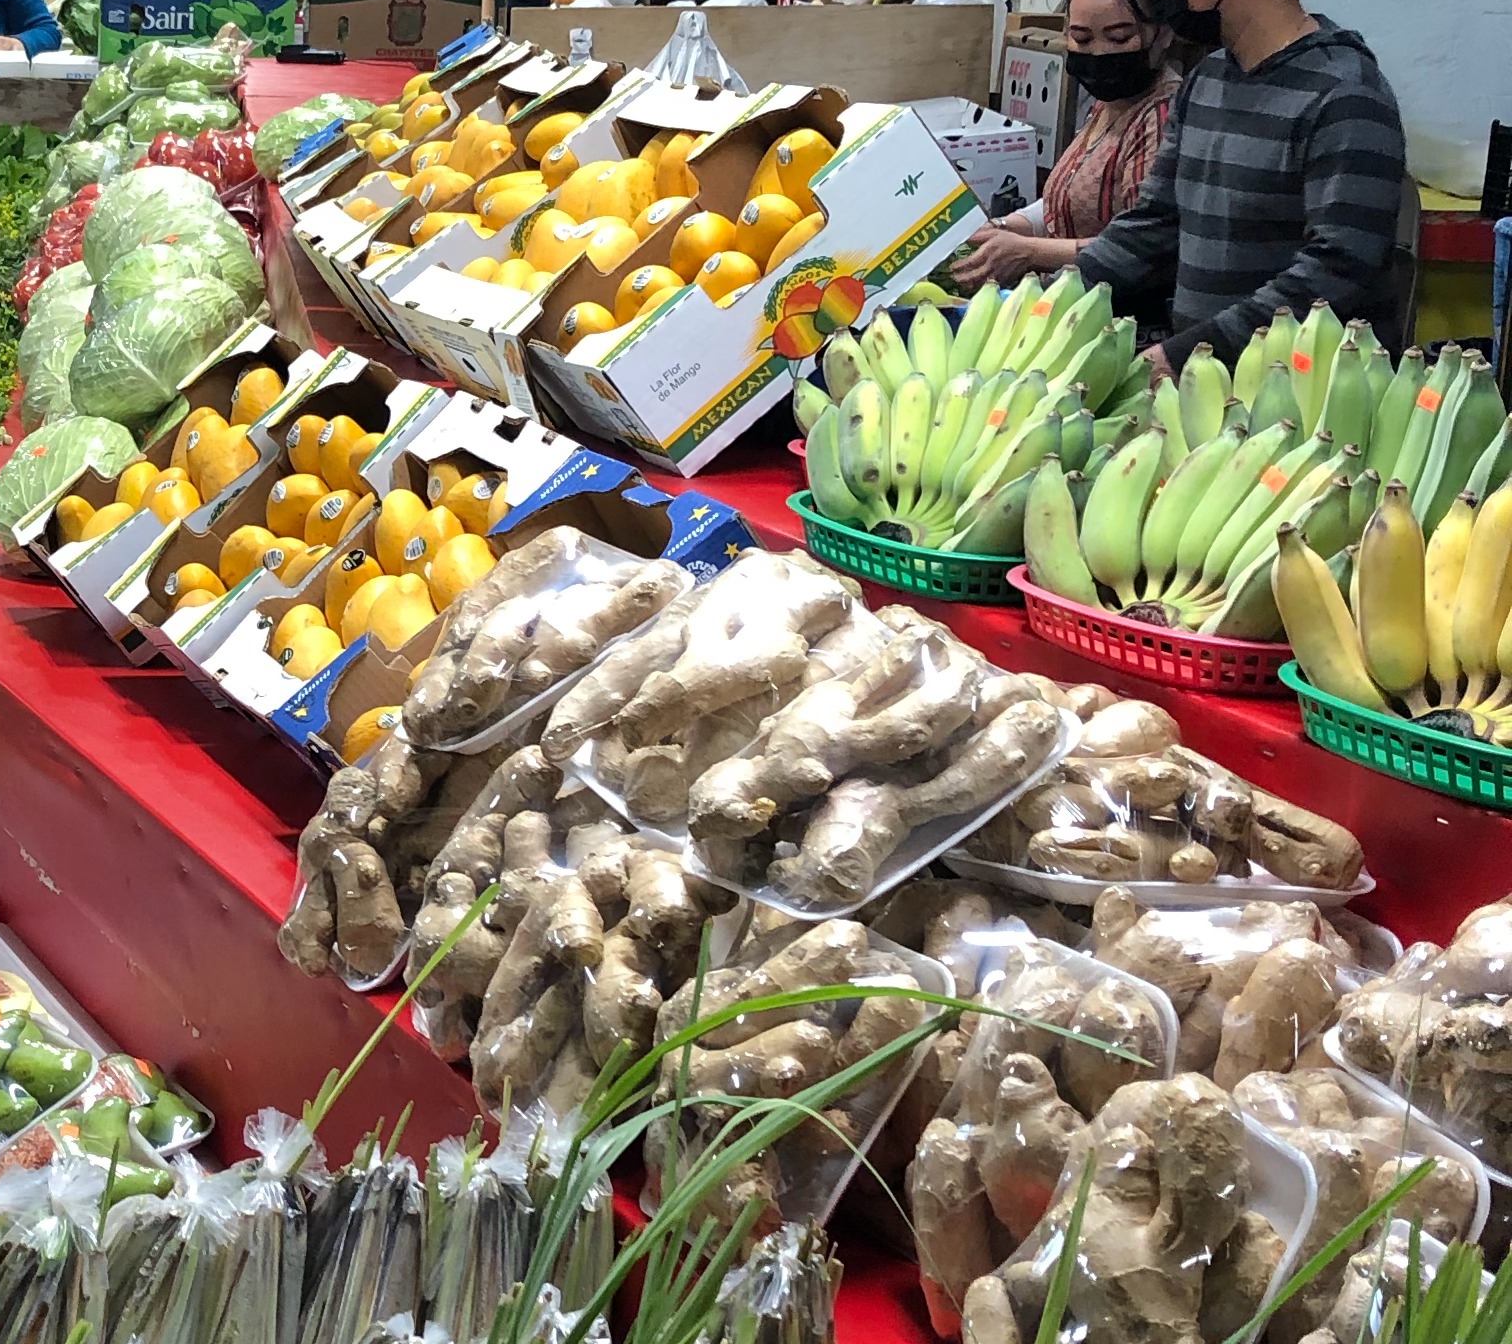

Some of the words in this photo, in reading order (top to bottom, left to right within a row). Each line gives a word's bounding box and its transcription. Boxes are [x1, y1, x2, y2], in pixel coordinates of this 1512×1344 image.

[141, 5, 195, 31] Sairi
[881, 207, 953, 276] BEAUTY
[777, 270, 822, 308] MANGOS
[649, 379, 665, 393] La
[662, 362, 682, 383] Flor
[657, 389, 671, 402] de
[669, 361, 702, 391] Mango
[692, 365, 773, 441] MEXICAN
